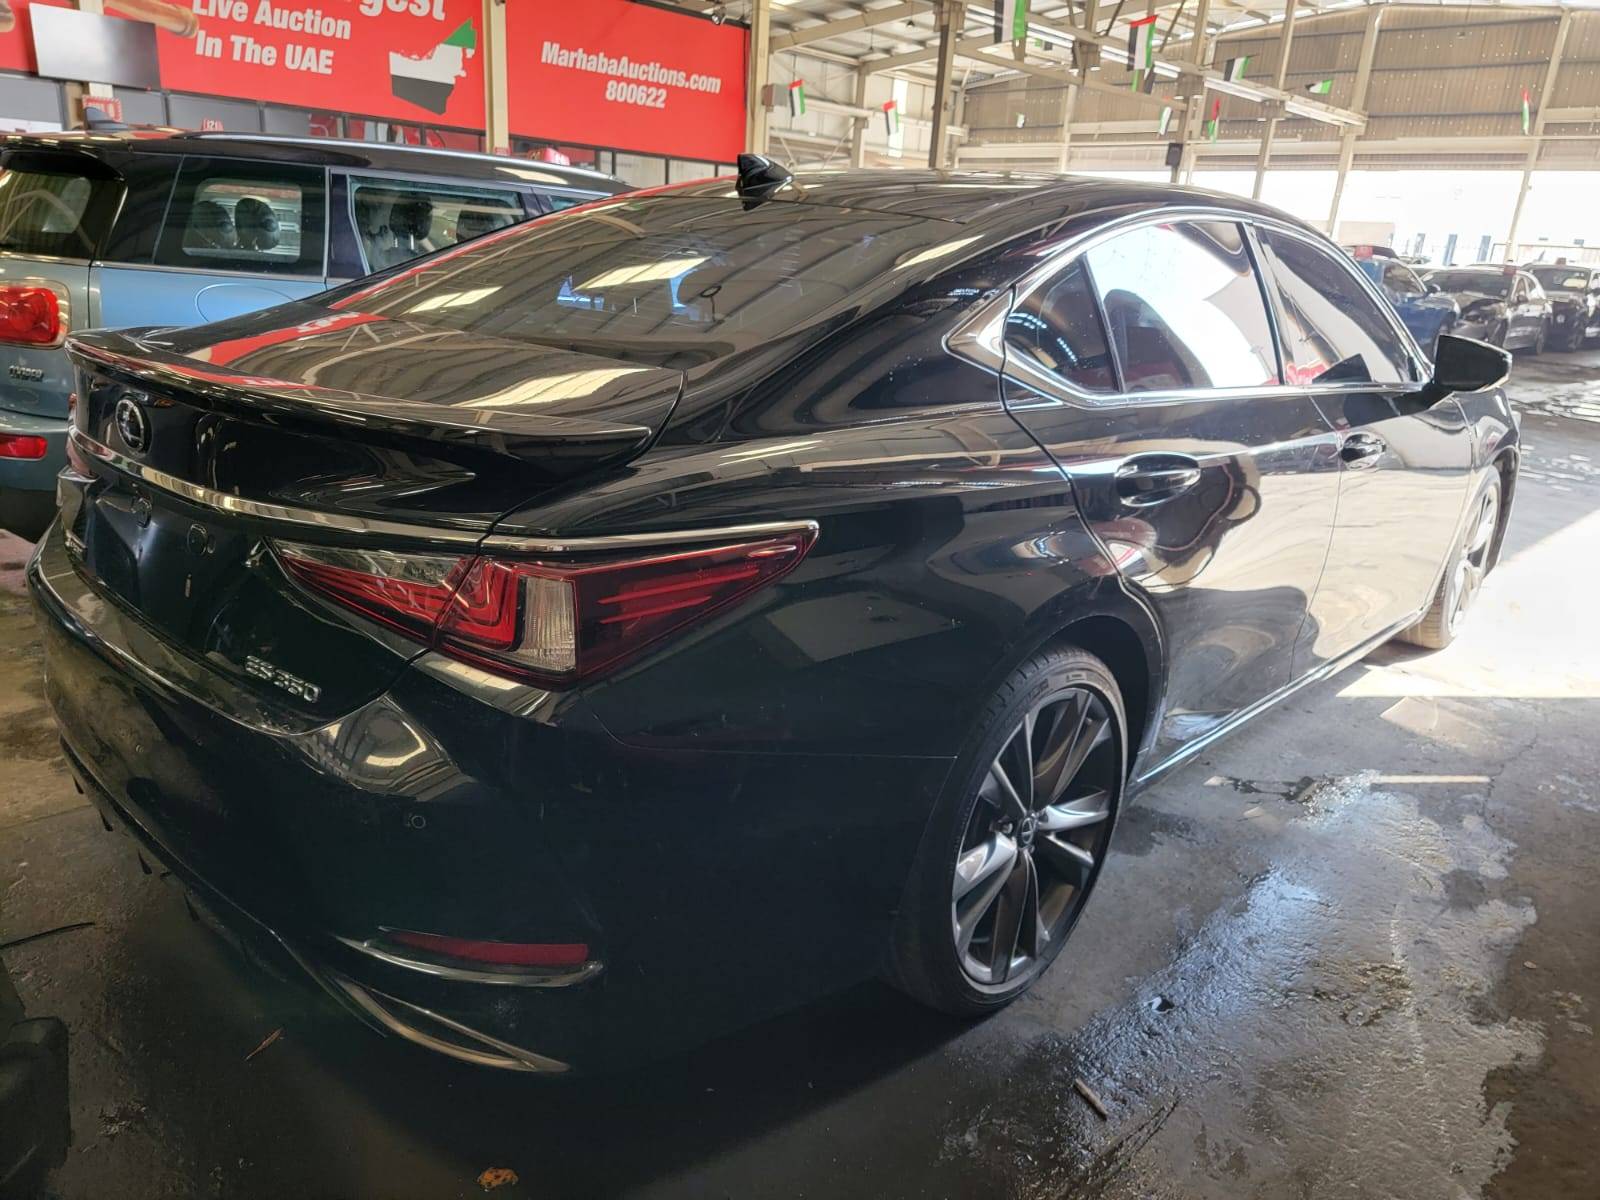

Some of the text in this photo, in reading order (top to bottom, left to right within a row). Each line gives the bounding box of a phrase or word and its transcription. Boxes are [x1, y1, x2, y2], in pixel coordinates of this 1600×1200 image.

[192, 0, 351, 40] Live Auction
[195, 30, 334, 75] In The UAE
[541, 41, 722, 94] MarhabaAuctions.com
[605, 79, 667, 109] 800622
